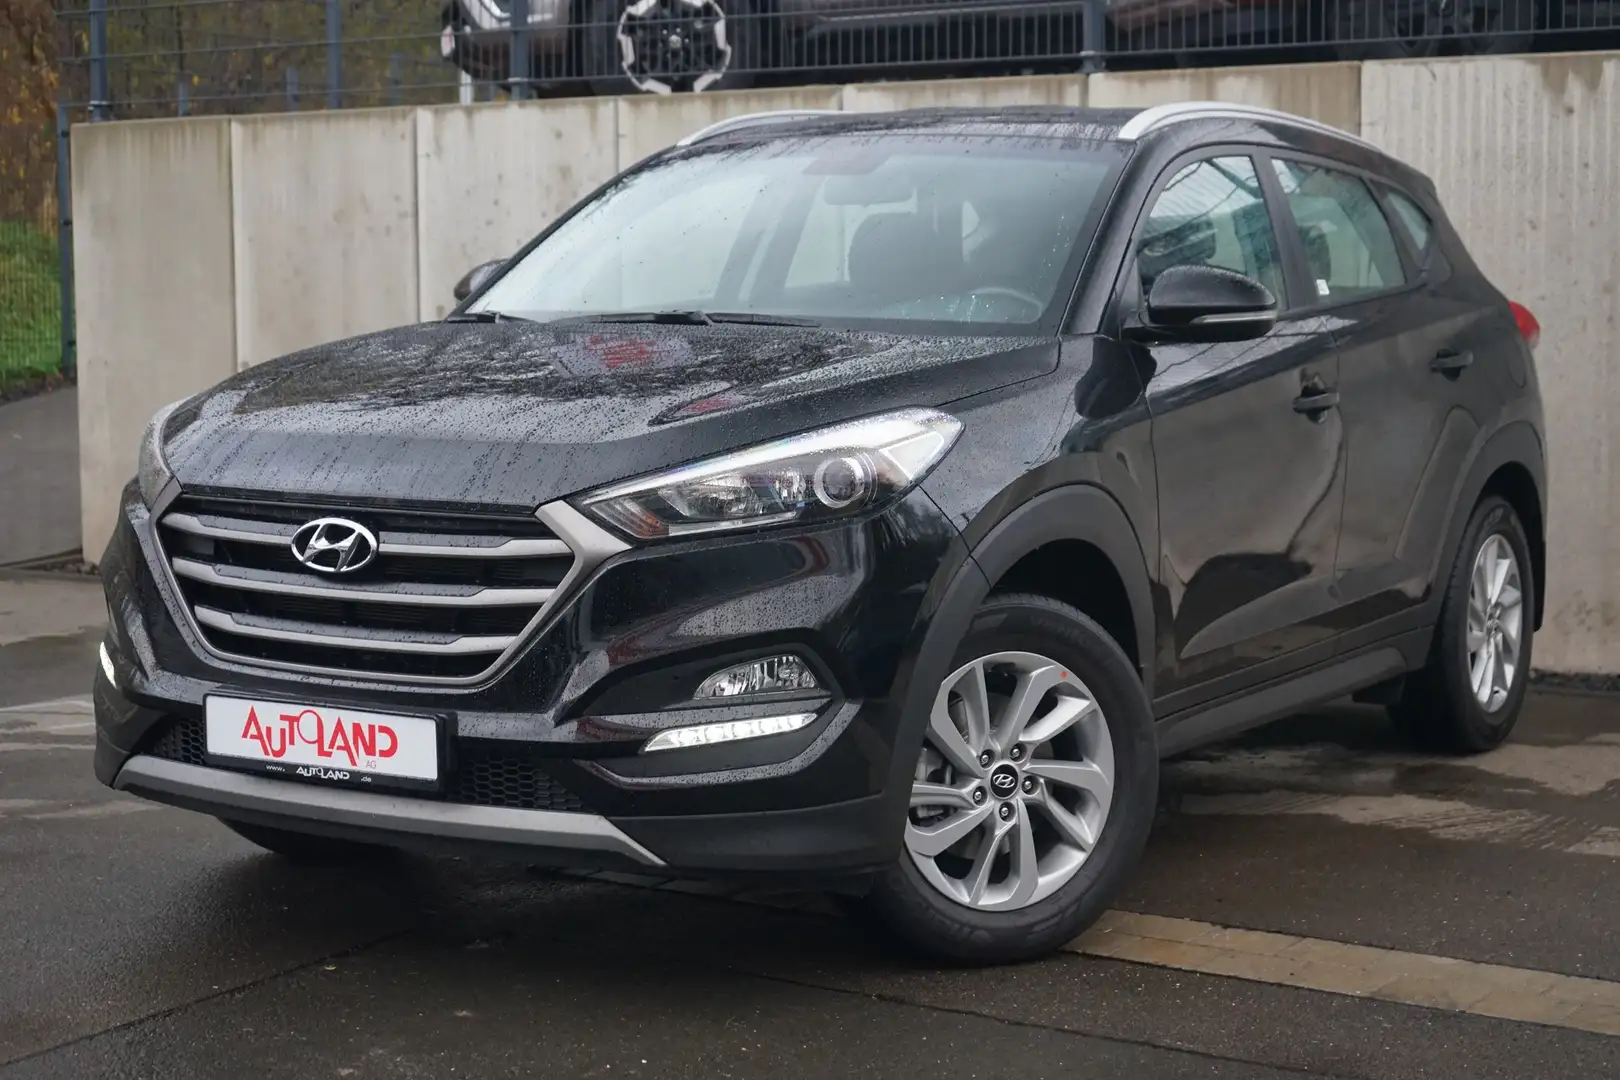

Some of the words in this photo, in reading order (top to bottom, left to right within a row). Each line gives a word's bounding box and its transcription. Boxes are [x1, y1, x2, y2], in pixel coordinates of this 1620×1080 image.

[241, 705, 398, 766] AUTOLAND
[365, 760, 377, 769] AG
[296, 766, 350, 780] AUTOLAND
